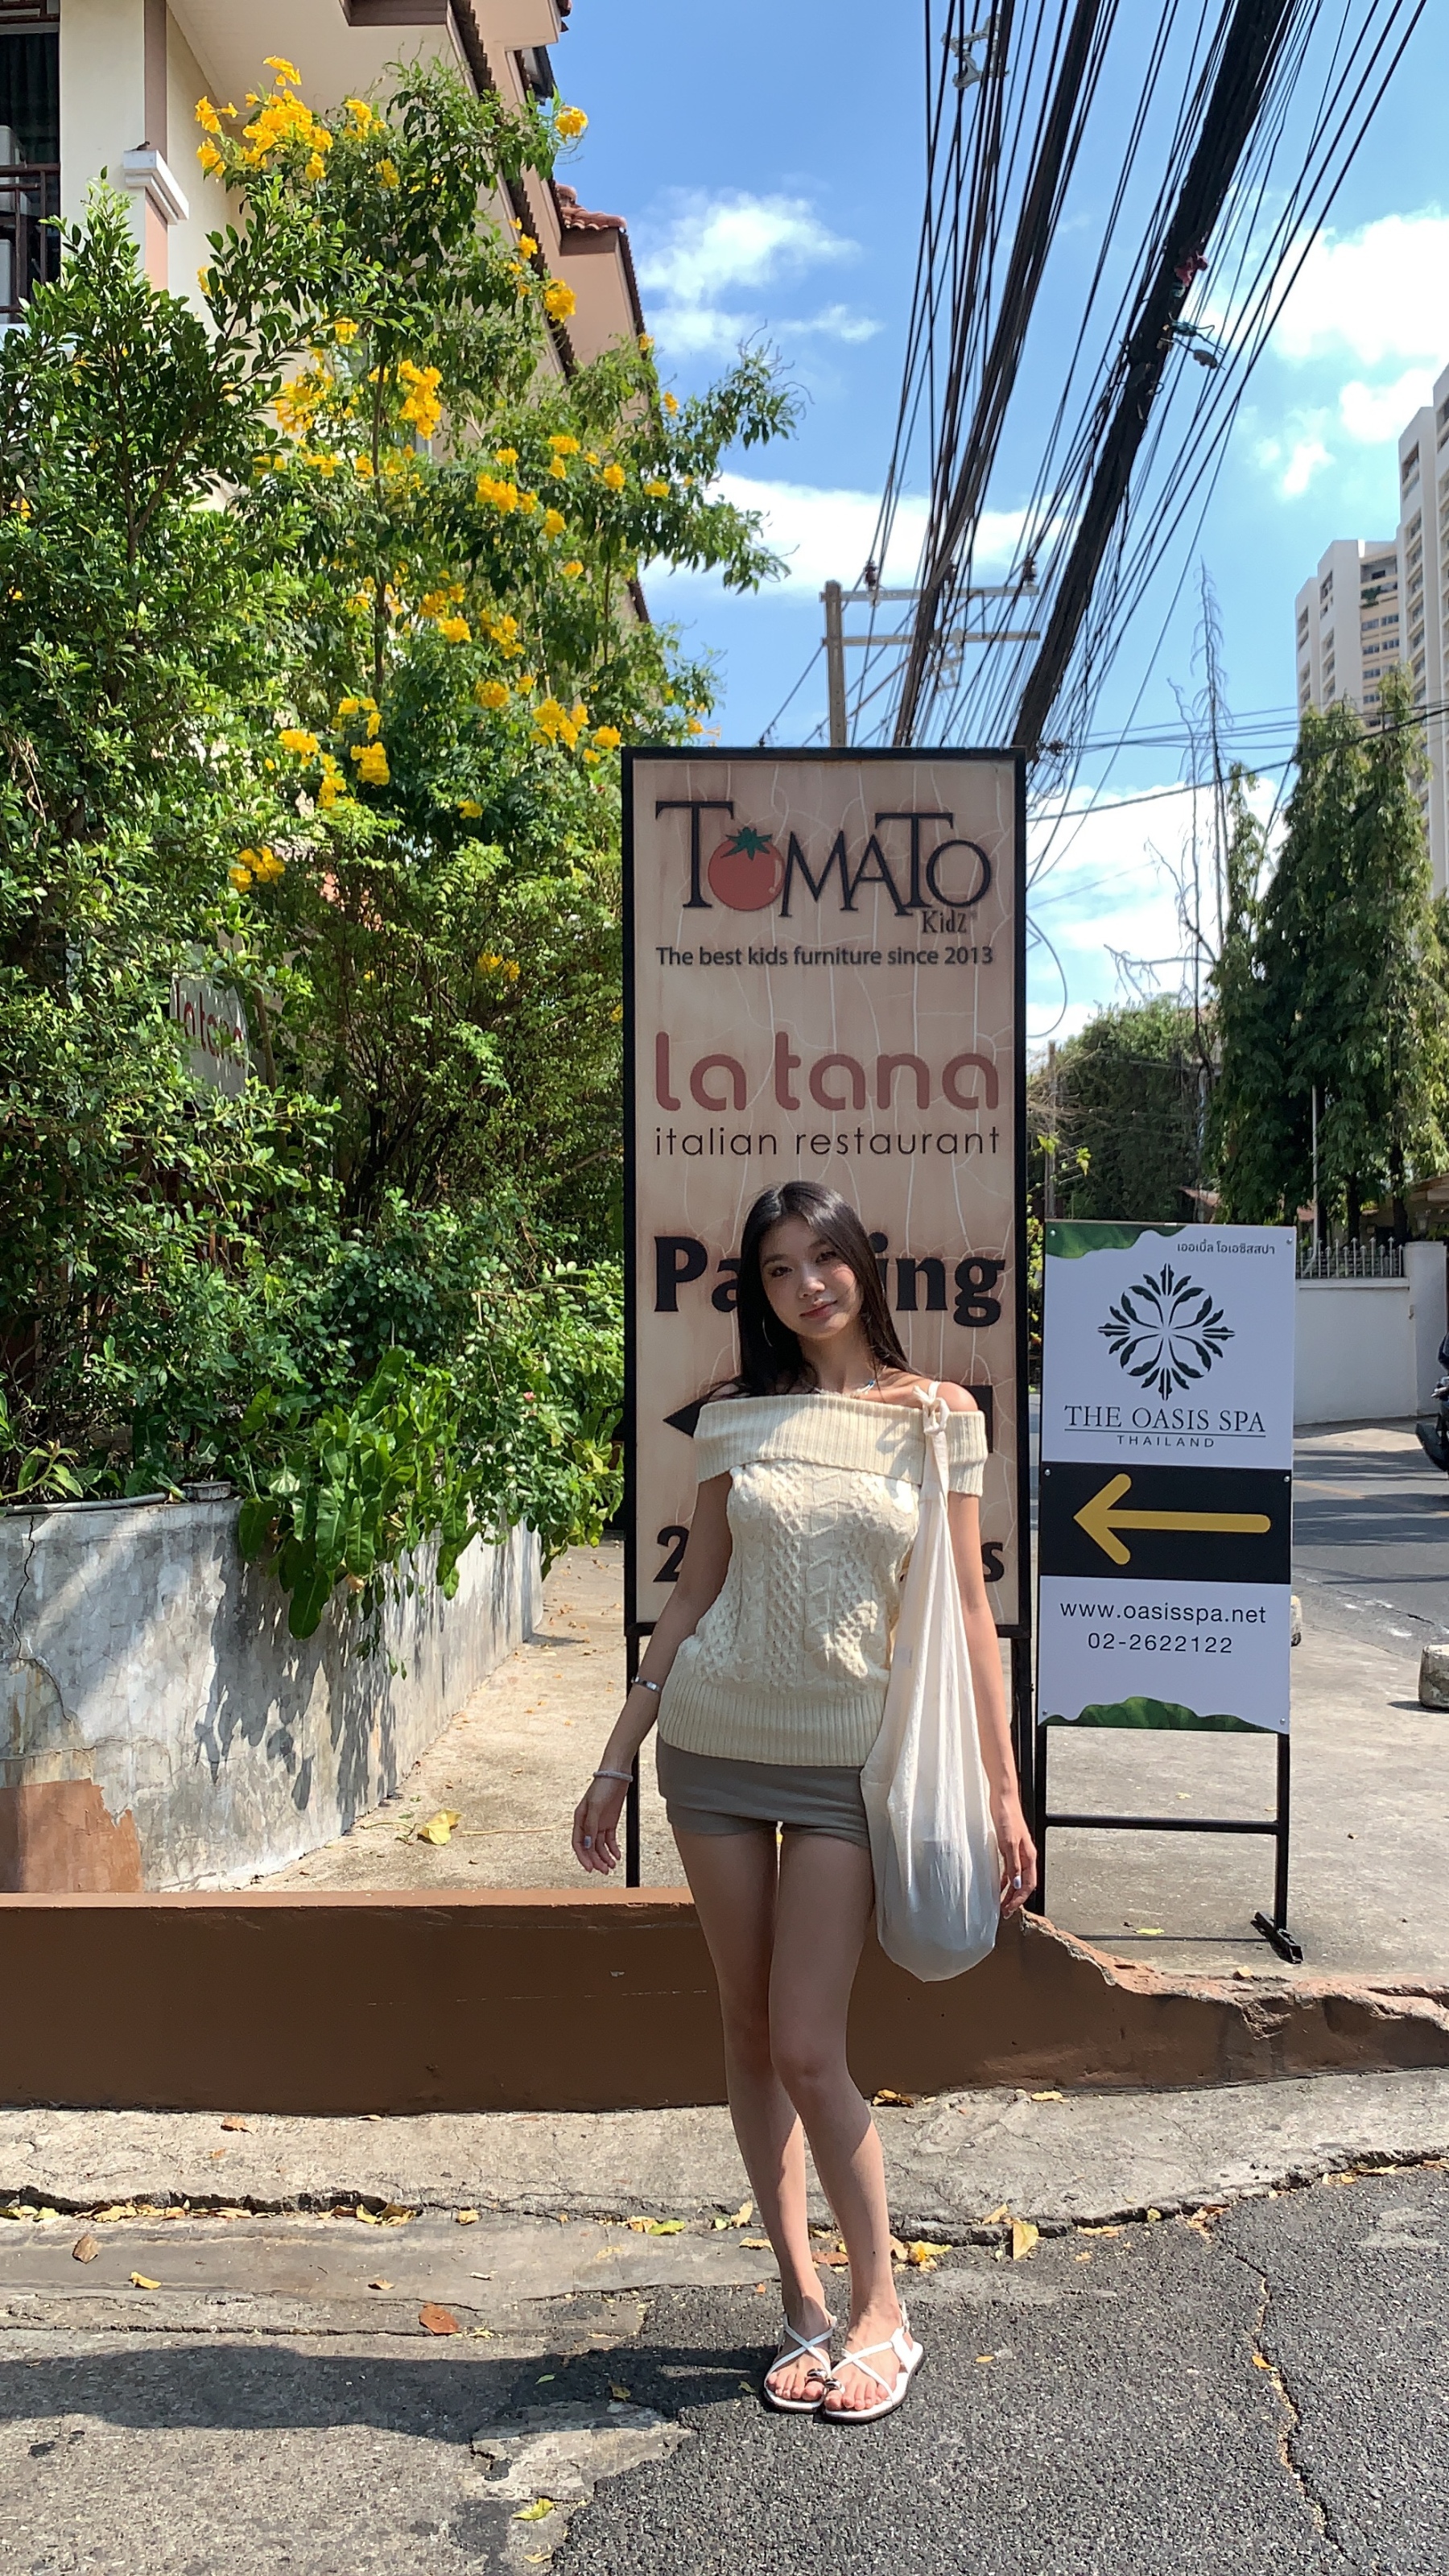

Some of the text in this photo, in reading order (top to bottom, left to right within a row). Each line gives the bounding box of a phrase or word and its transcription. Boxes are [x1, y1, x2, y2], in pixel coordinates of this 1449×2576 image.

[655, 945, 994, 966] The best kids furniture since 2013
[655, 1030, 1000, 1112] la tana
[655, 1126, 1000, 1156] italian restaurant
[1063, 1405, 1265, 1432] THE OASIS SPA
[1117, 1435, 1215, 1448] THAILAND
[1059, 1602, 1266, 1626] www.oasisspa.net
[1088, 1632, 1232, 1653] 02-2622122
